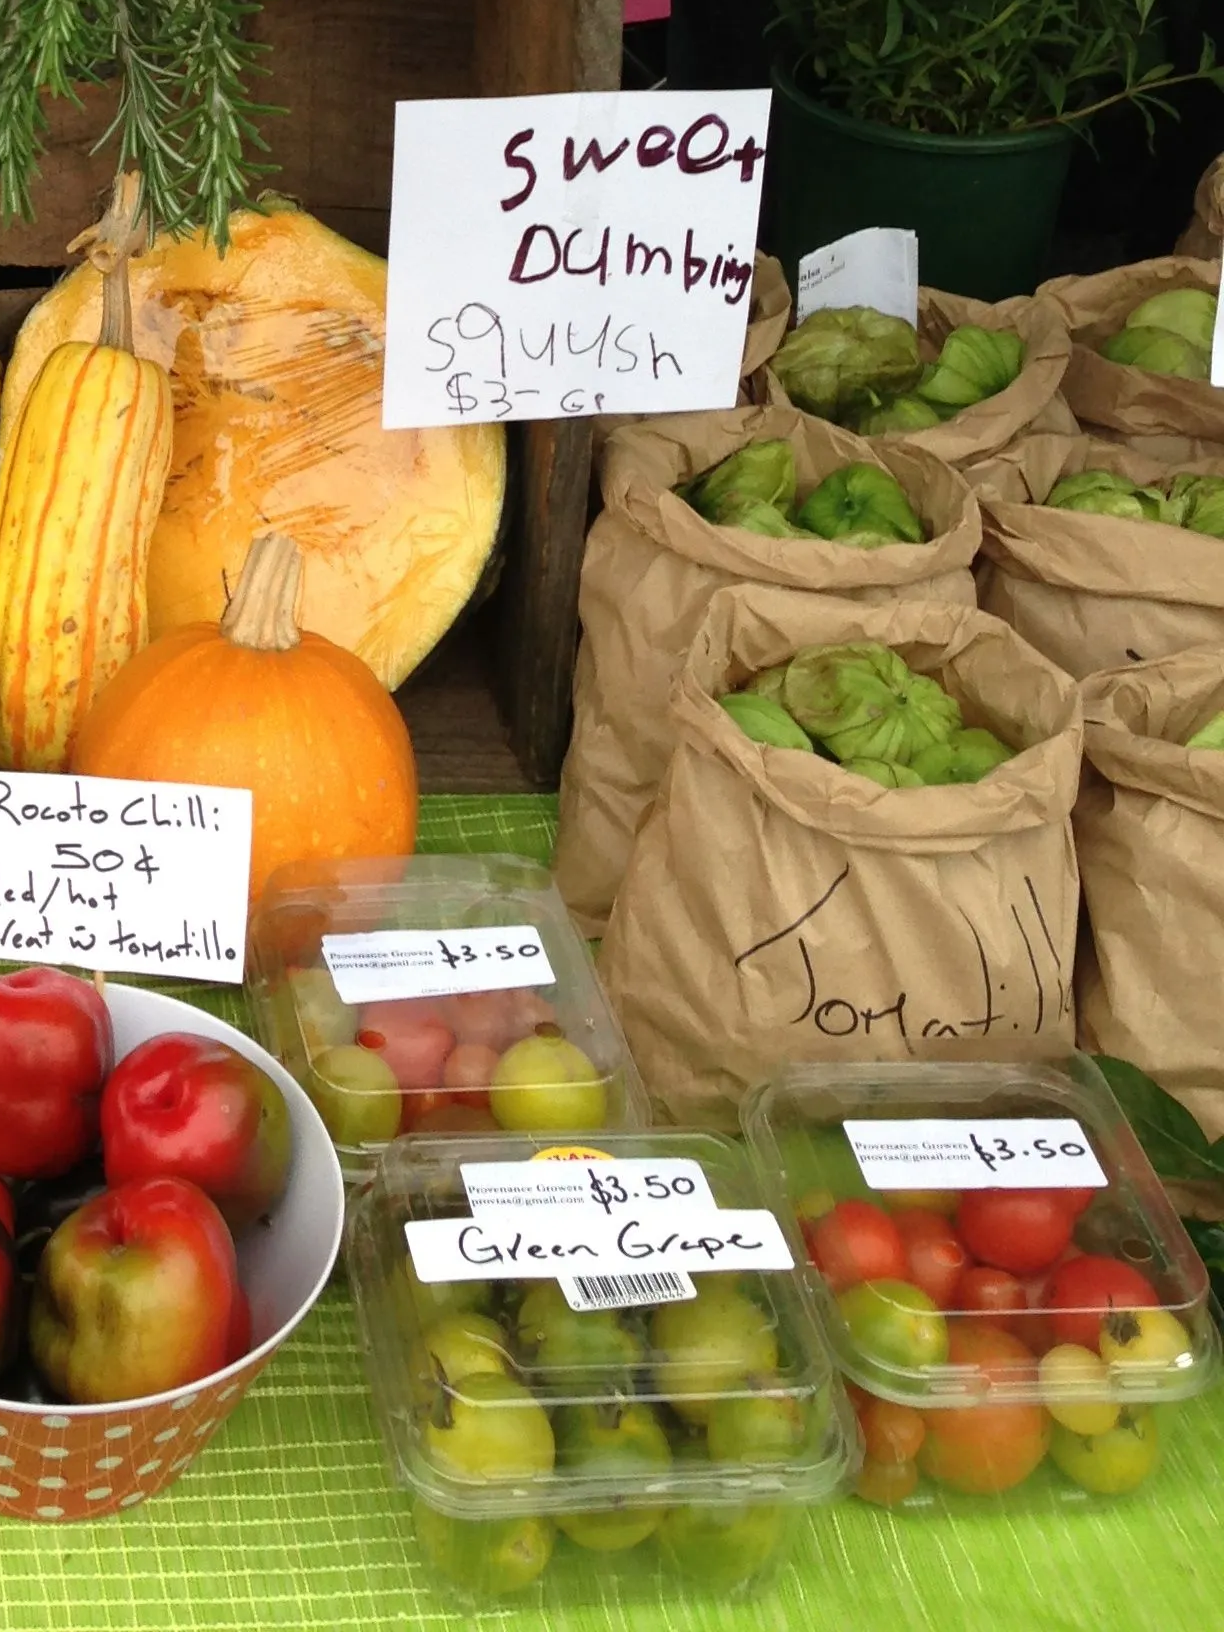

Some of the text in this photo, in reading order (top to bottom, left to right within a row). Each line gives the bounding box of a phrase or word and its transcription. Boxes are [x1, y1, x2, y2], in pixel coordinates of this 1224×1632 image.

[436, 939, 540, 970] $3.50
[969, 1133, 1086, 1172] $3.50
[587, 1168, 696, 1215] $3.50
[458, 1220, 764, 1265] Green Grape
